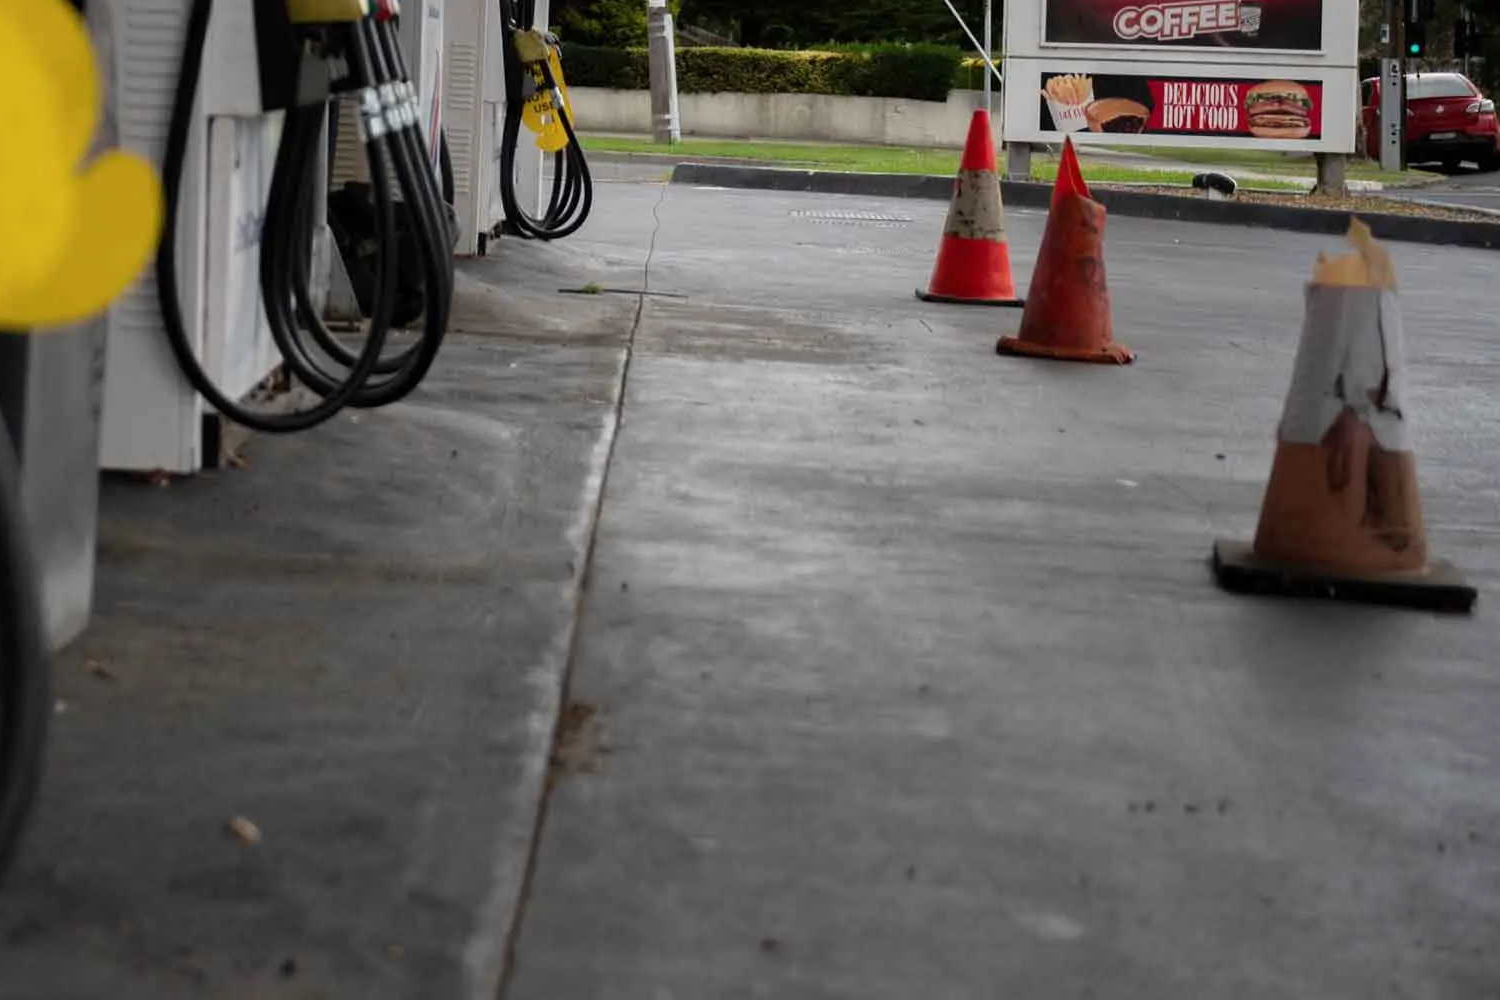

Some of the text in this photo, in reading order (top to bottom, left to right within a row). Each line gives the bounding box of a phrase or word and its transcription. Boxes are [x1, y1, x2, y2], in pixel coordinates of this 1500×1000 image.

[1115, 0, 1240, 39] COFFEE
[1163, 82, 1238, 107] DELICIOUS
[1163, 105, 1238, 130] HOT FOOD
